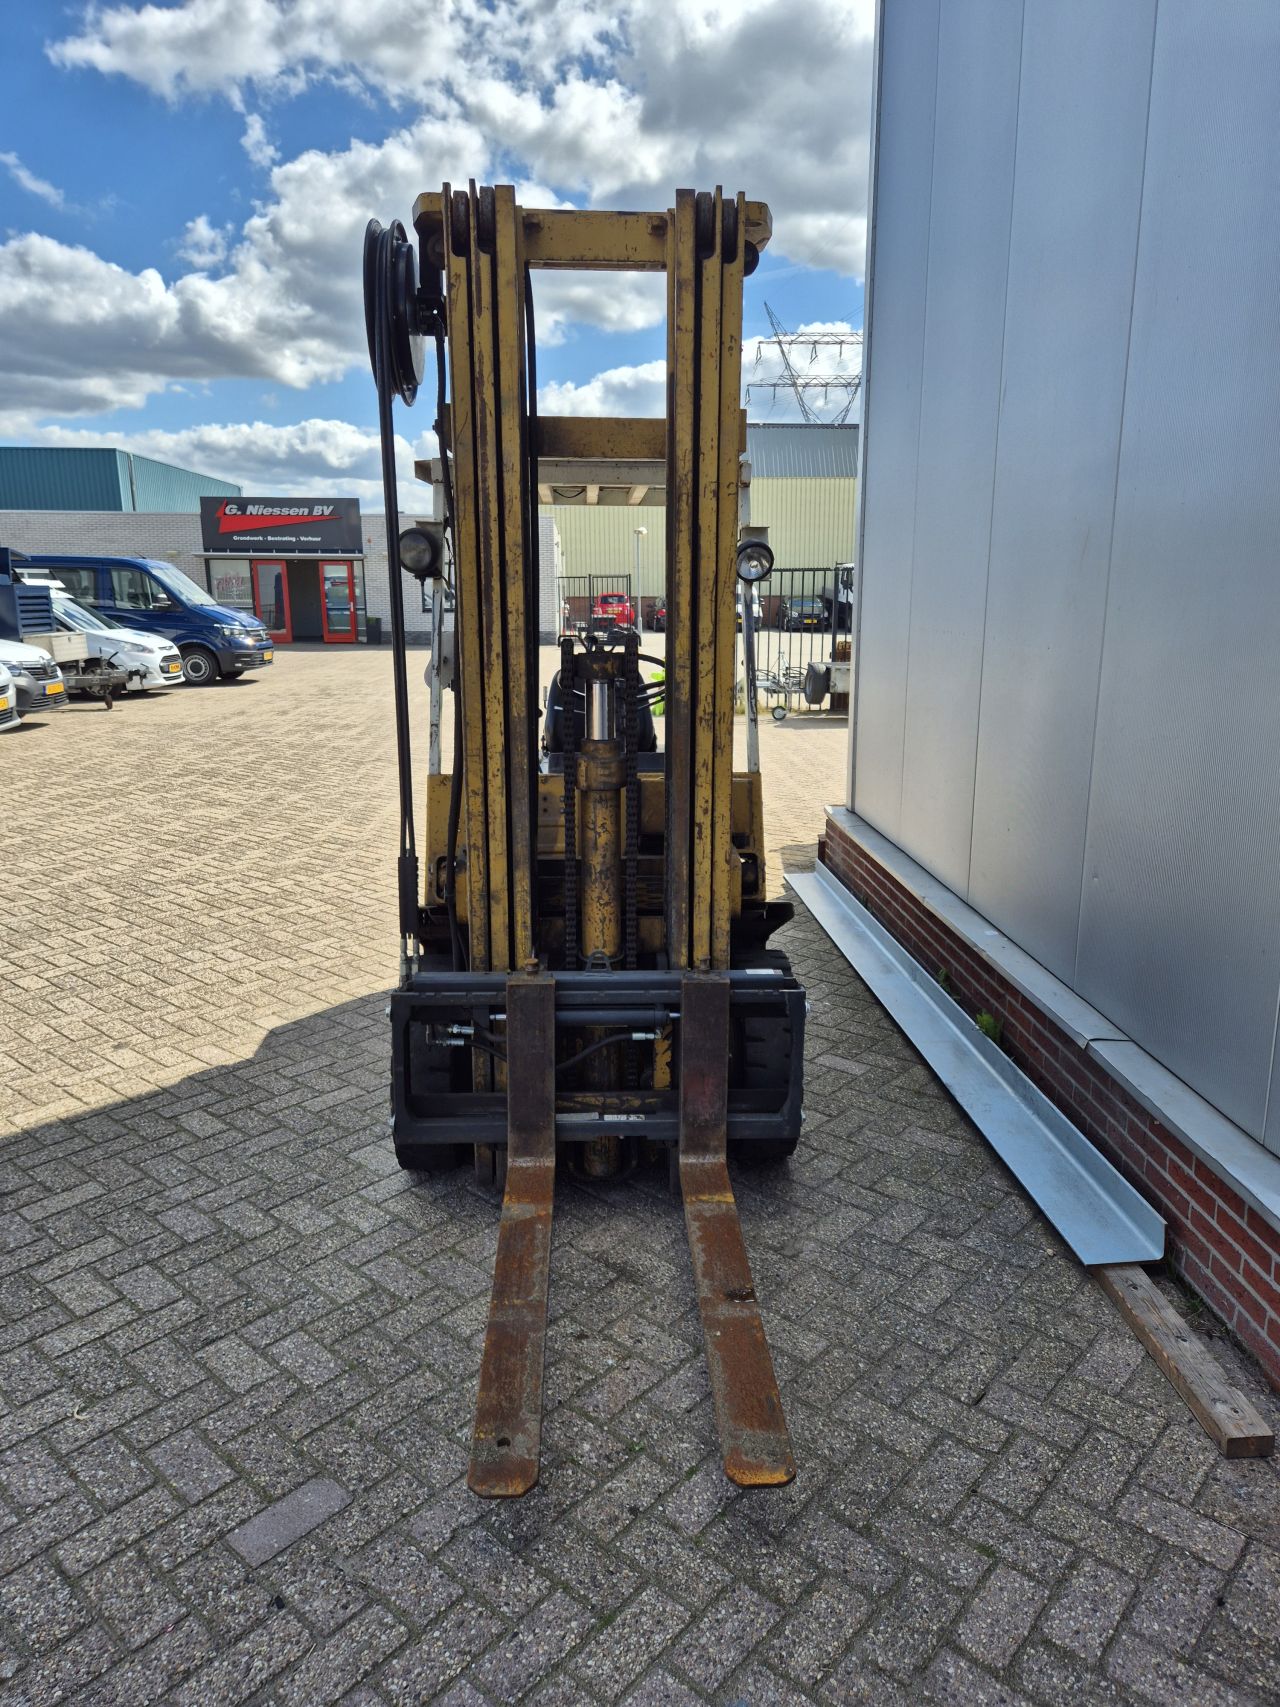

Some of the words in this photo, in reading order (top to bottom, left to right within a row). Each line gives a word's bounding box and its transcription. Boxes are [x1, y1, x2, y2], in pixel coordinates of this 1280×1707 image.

[225, 504, 241, 515] G.
[246, 505, 311, 516] Niessen
[313, 505, 334, 516] BV
